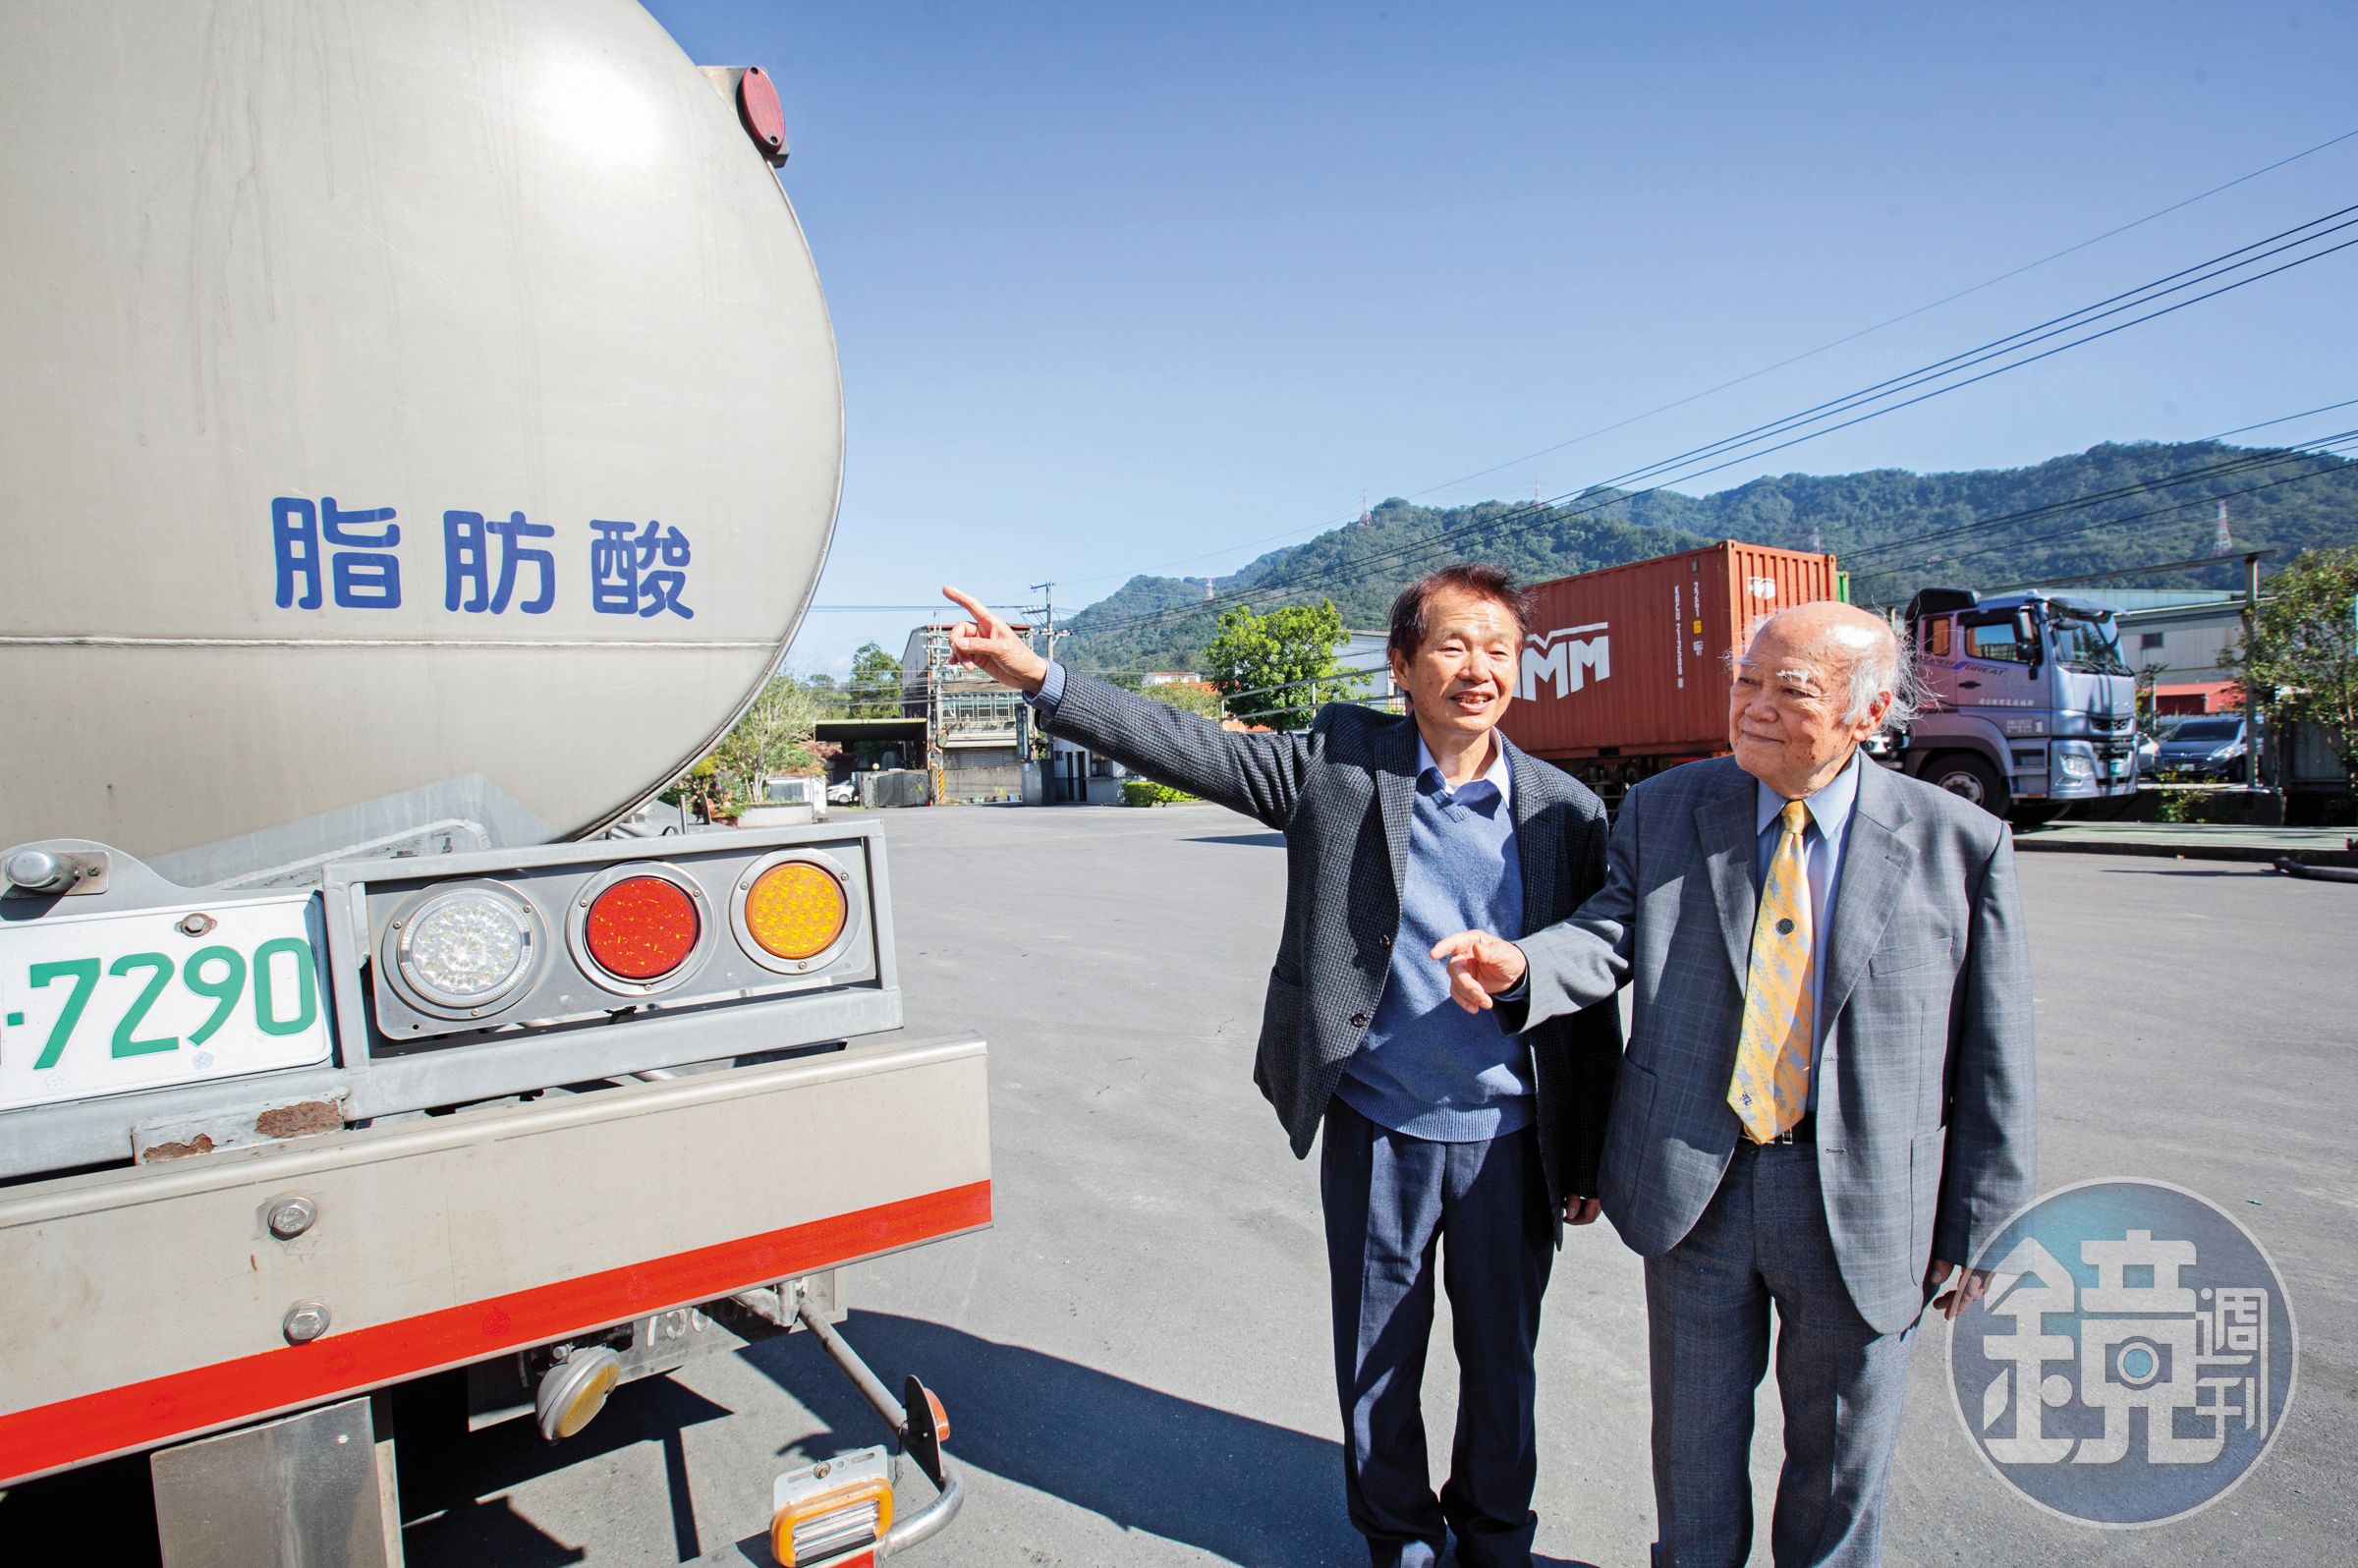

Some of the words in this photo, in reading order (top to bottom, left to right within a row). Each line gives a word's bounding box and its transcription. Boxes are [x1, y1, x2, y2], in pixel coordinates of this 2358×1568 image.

[271, 496, 695, 620] 脂肪酸
[1512, 622, 1610, 701] MM
[7, 936, 317, 1071] -7290
